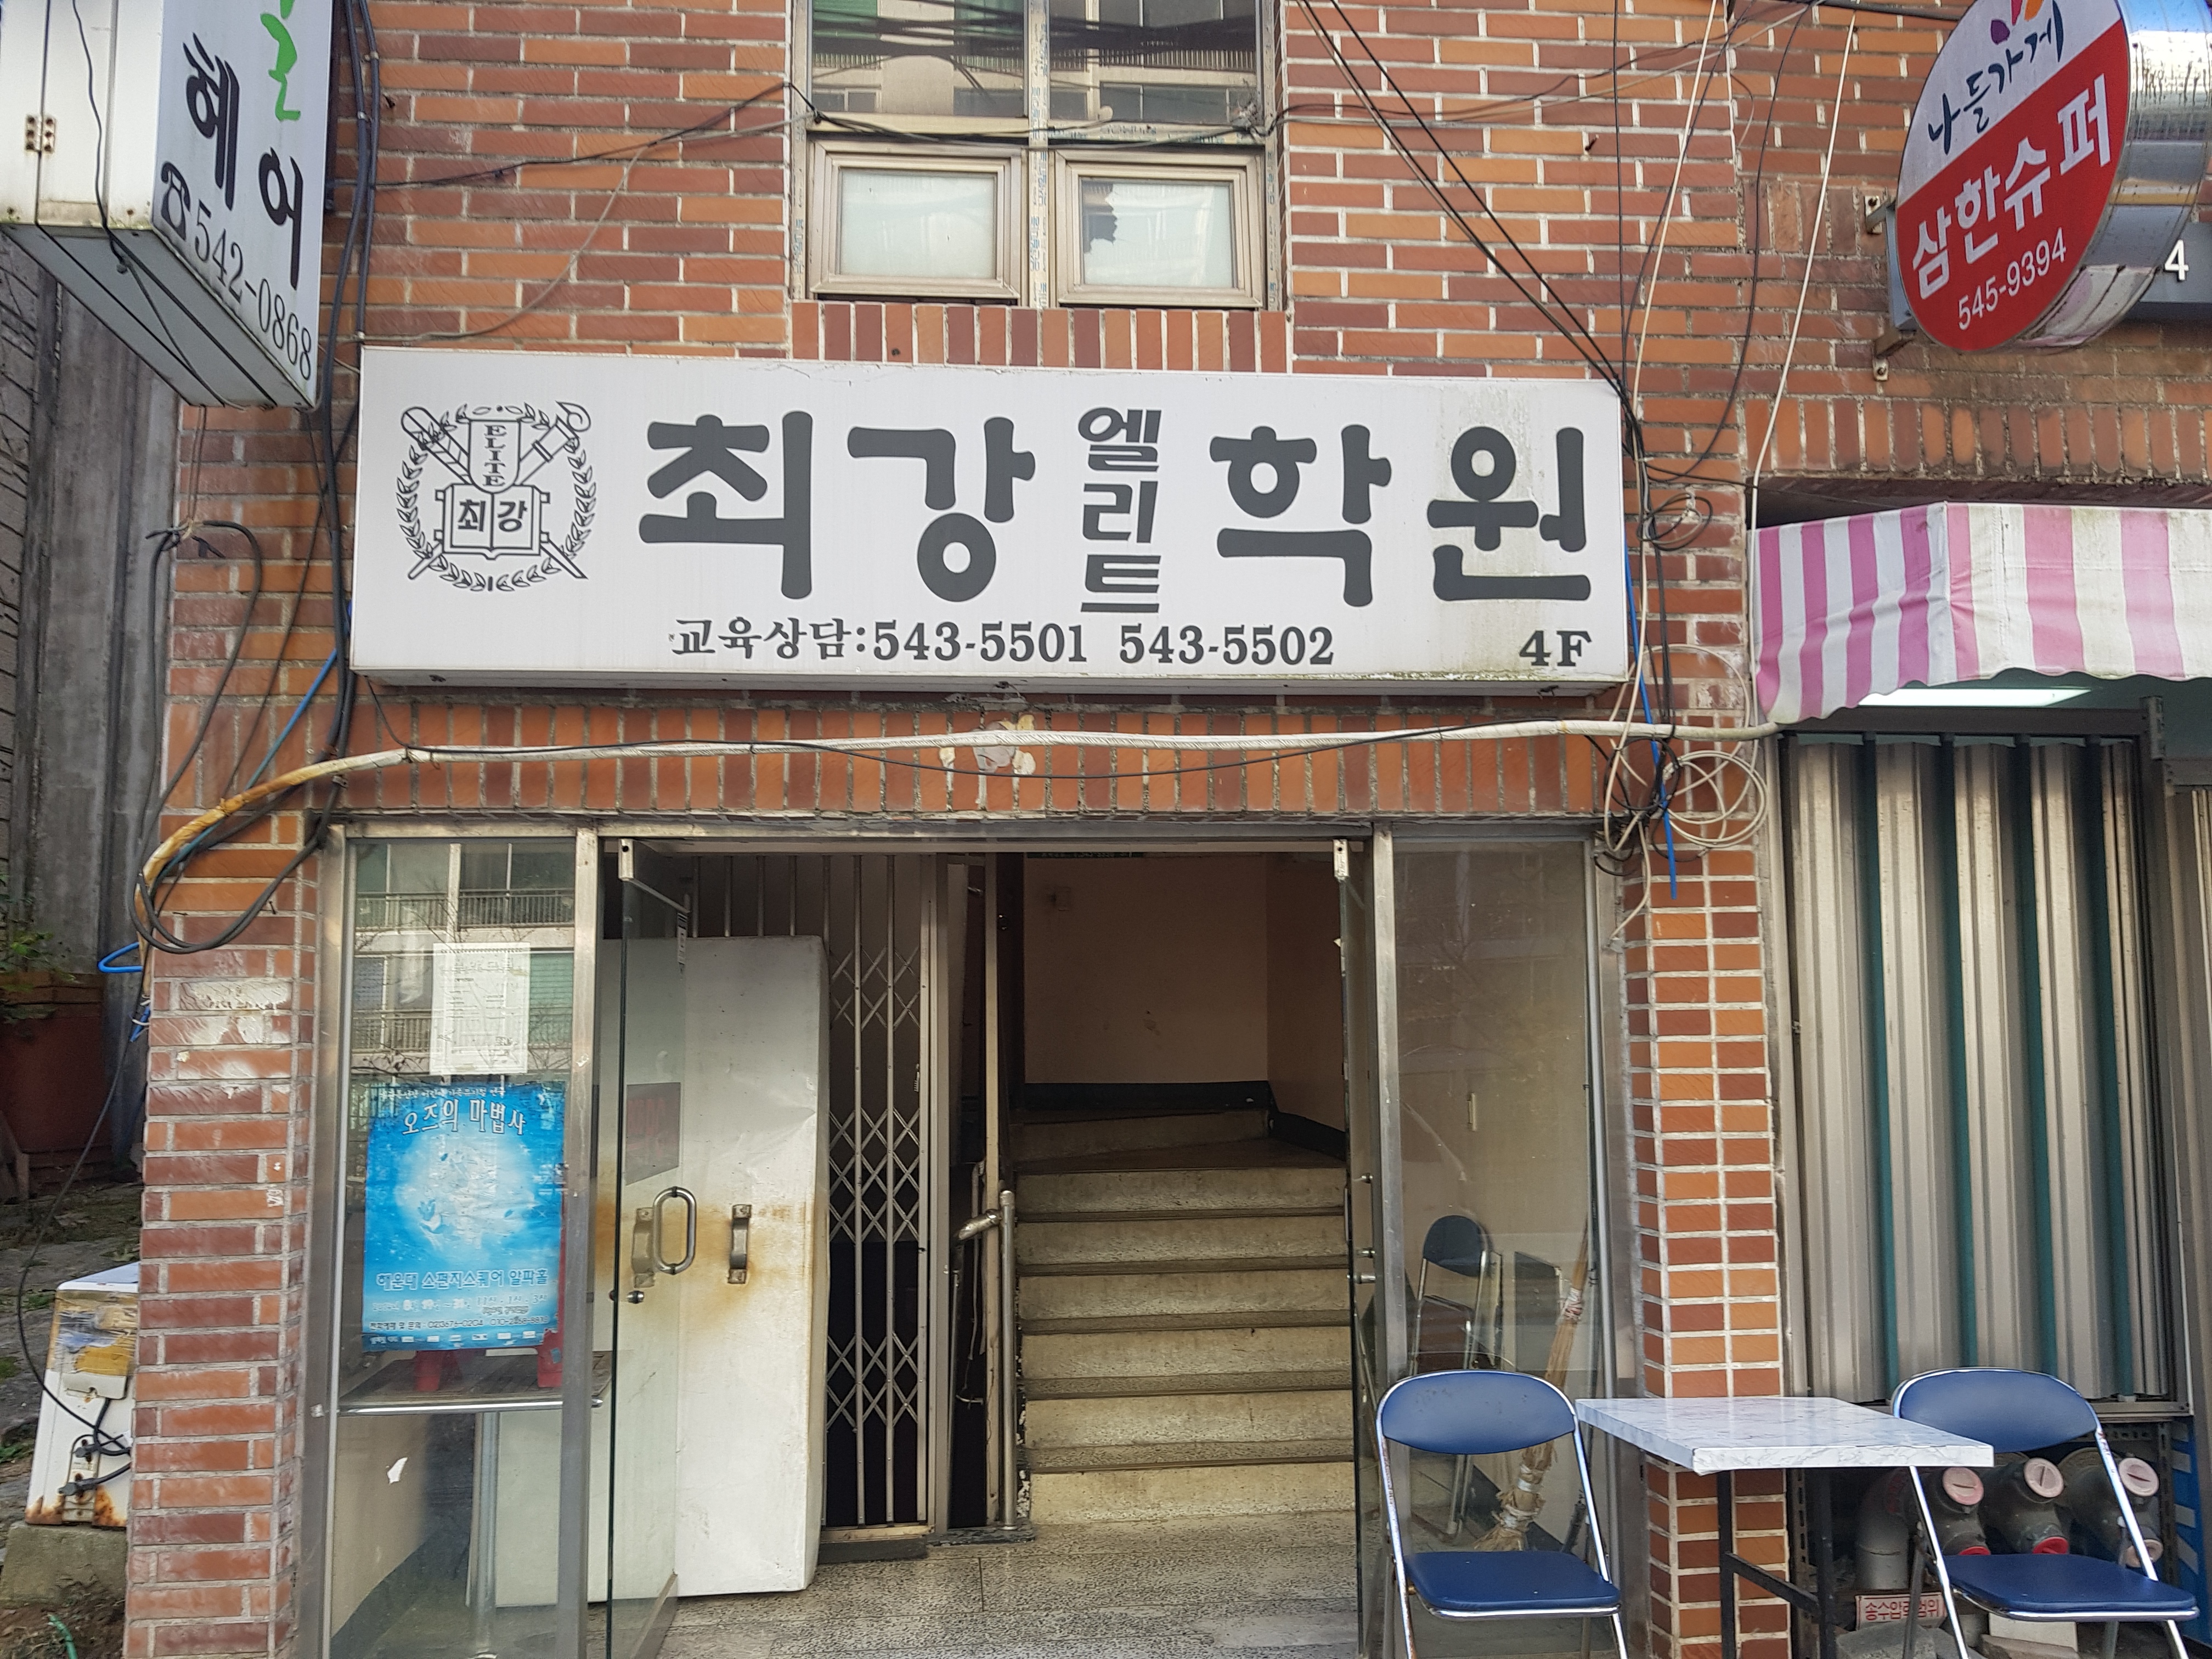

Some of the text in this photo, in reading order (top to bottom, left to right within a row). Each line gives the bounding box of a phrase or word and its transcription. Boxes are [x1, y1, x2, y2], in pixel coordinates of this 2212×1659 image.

[1928, 0, 2064, 155] 나들가게
[1912, 73, 2111, 300] 삼한슈퍼
[195, 199, 311, 380] 542-0868
[1957, 227, 2067, 330] 545-9394
[2164, 239, 2189, 280] 4
[482, 424, 507, 486] ELITE
[1078, 407, 1161, 613] 엘리트
[1210, 424, 1590, 607] 학원
[1119, 623, 1334, 665] 543-5502
[1519, 630, 1592, 667] 4F
[402, 1098, 526, 1136] 오즈의 마법사
[508, 1268, 548, 1287] 알파홀
